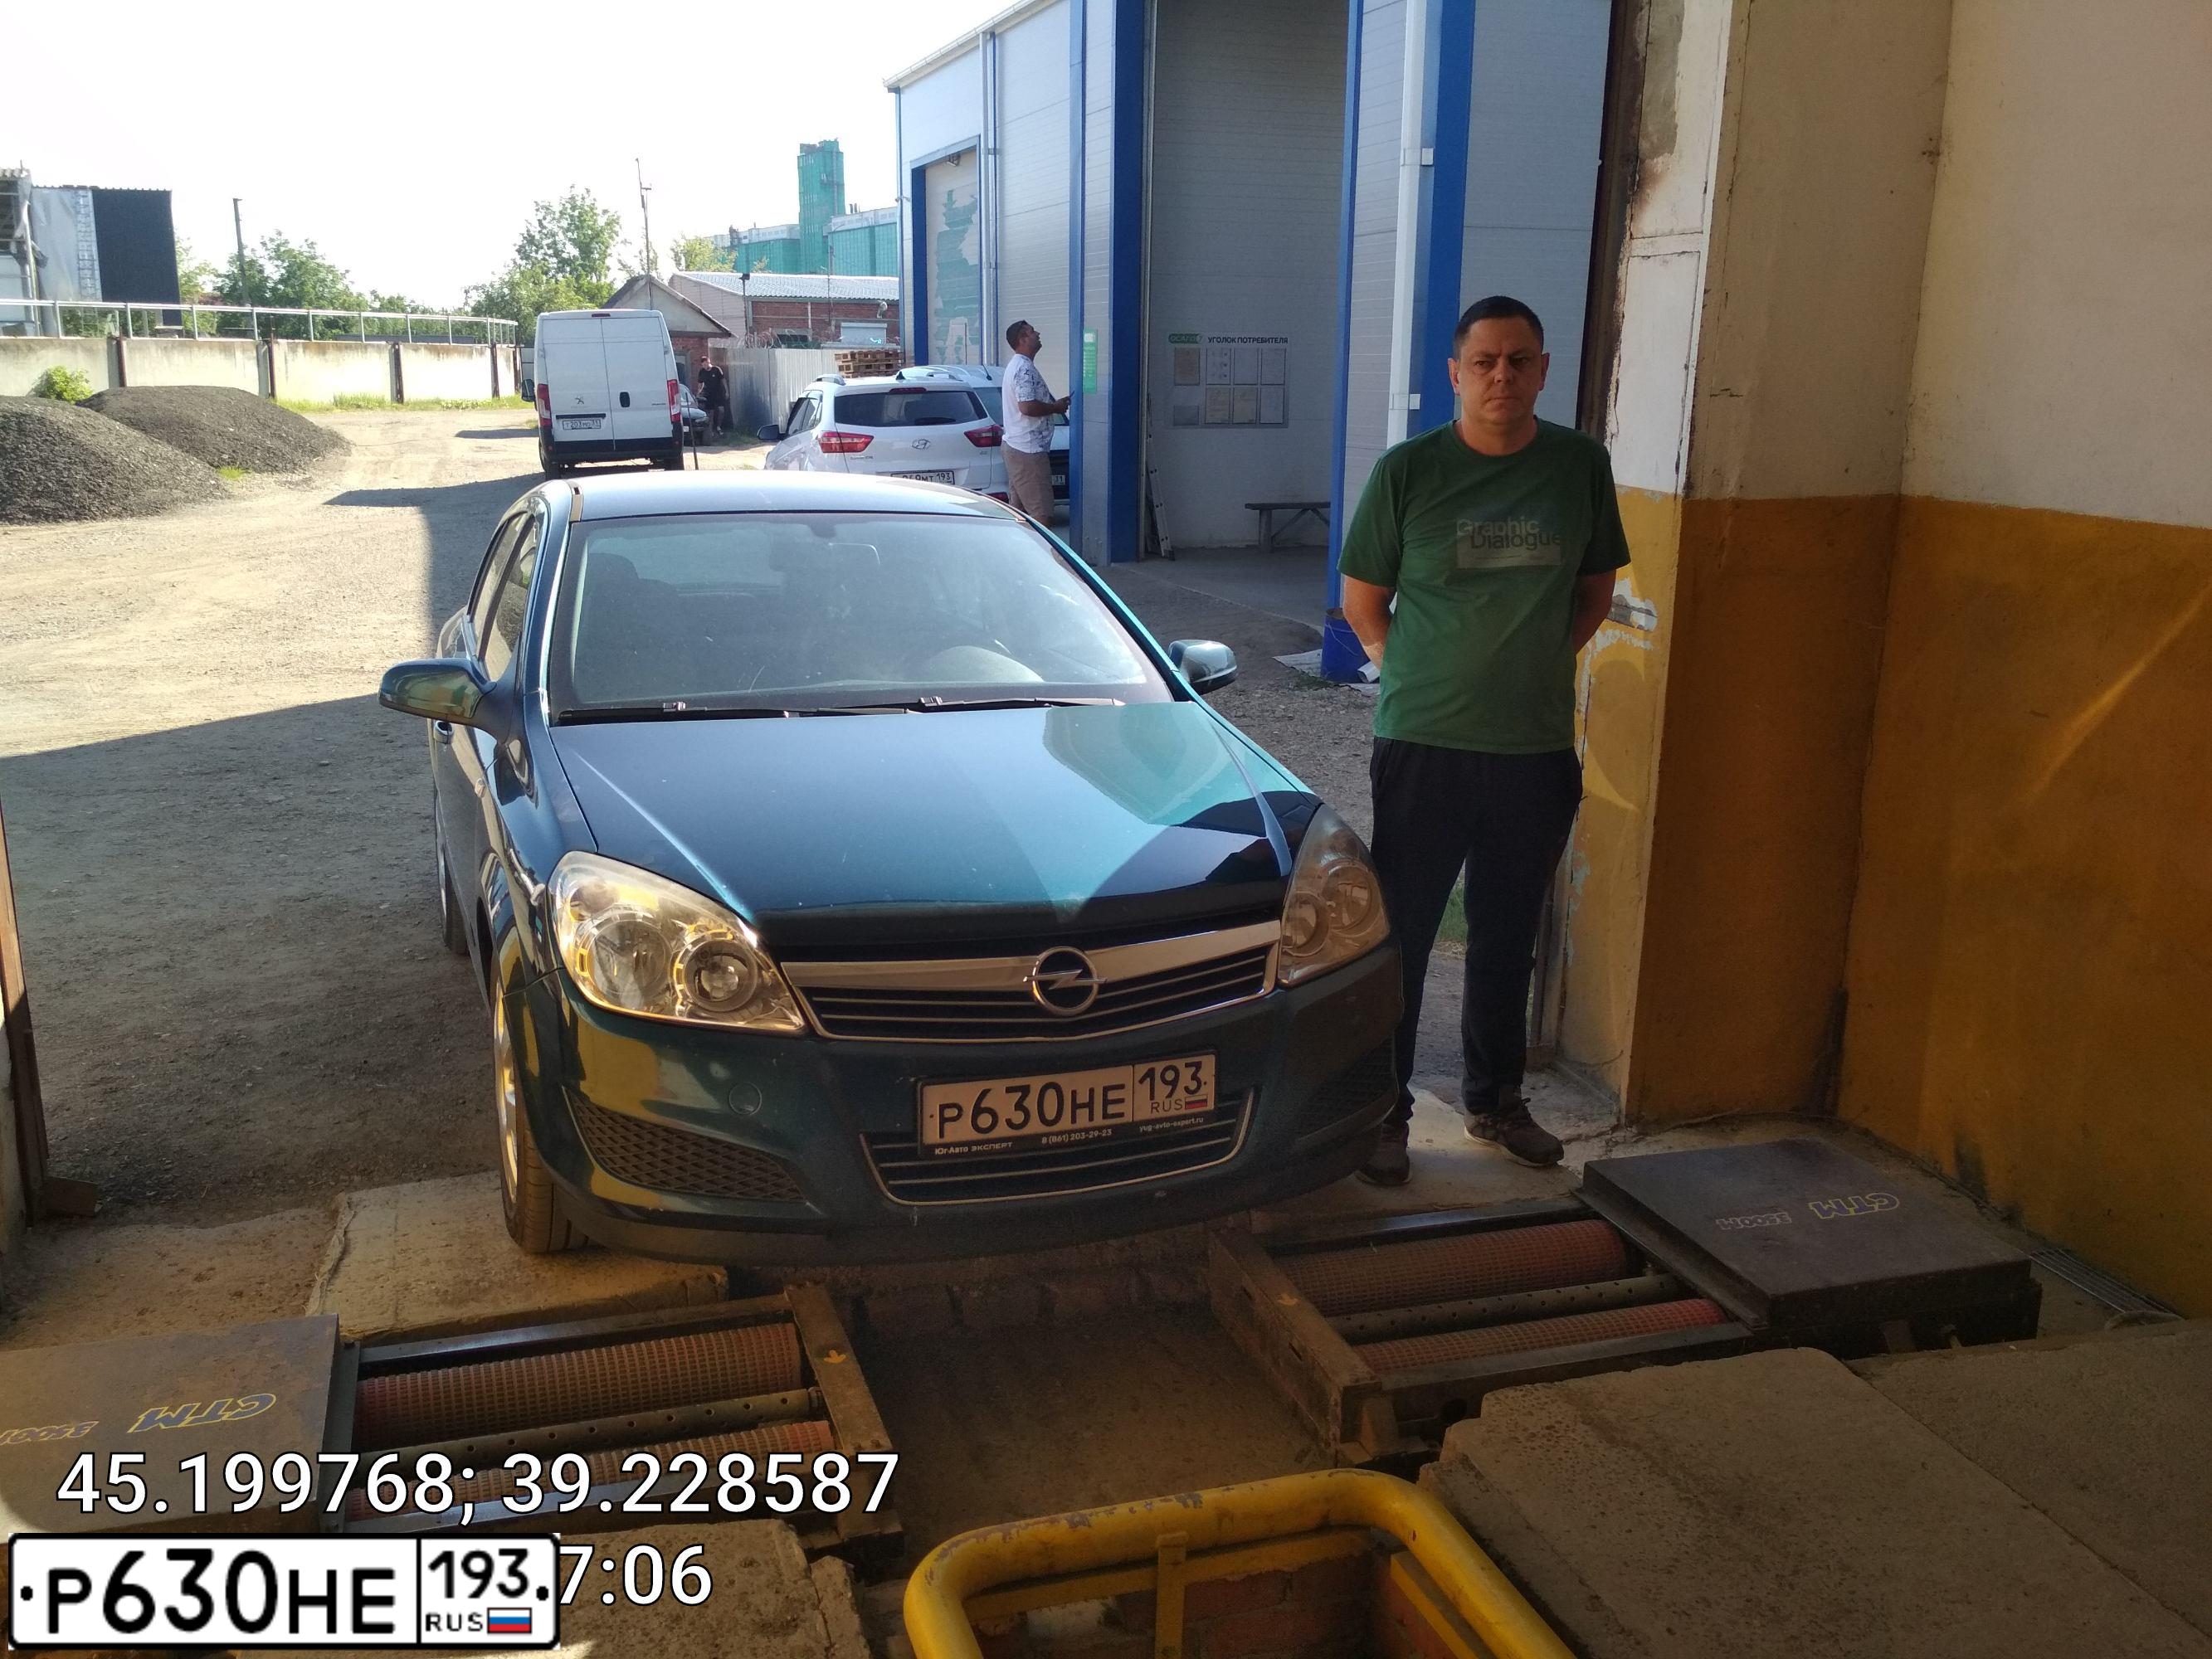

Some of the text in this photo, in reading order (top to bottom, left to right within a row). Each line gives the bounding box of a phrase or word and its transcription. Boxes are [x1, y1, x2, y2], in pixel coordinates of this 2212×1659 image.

[936, 472, 951, 481] 193
[1456, 515, 1540, 536] Graphic
[1470, 530, 1561, 551] Dialogue
[937, 1060, 1204, 1140] Р630НЕ 193
[1150, 1097, 1183, 1114] RUS
[1139, 1117, 1204, 1133] yug-avto-expert.ru
[1069, 1129, 1113, 1141] 203-29-23
[971, 1141, 1013, 1152] ЭКСПЕРТ
